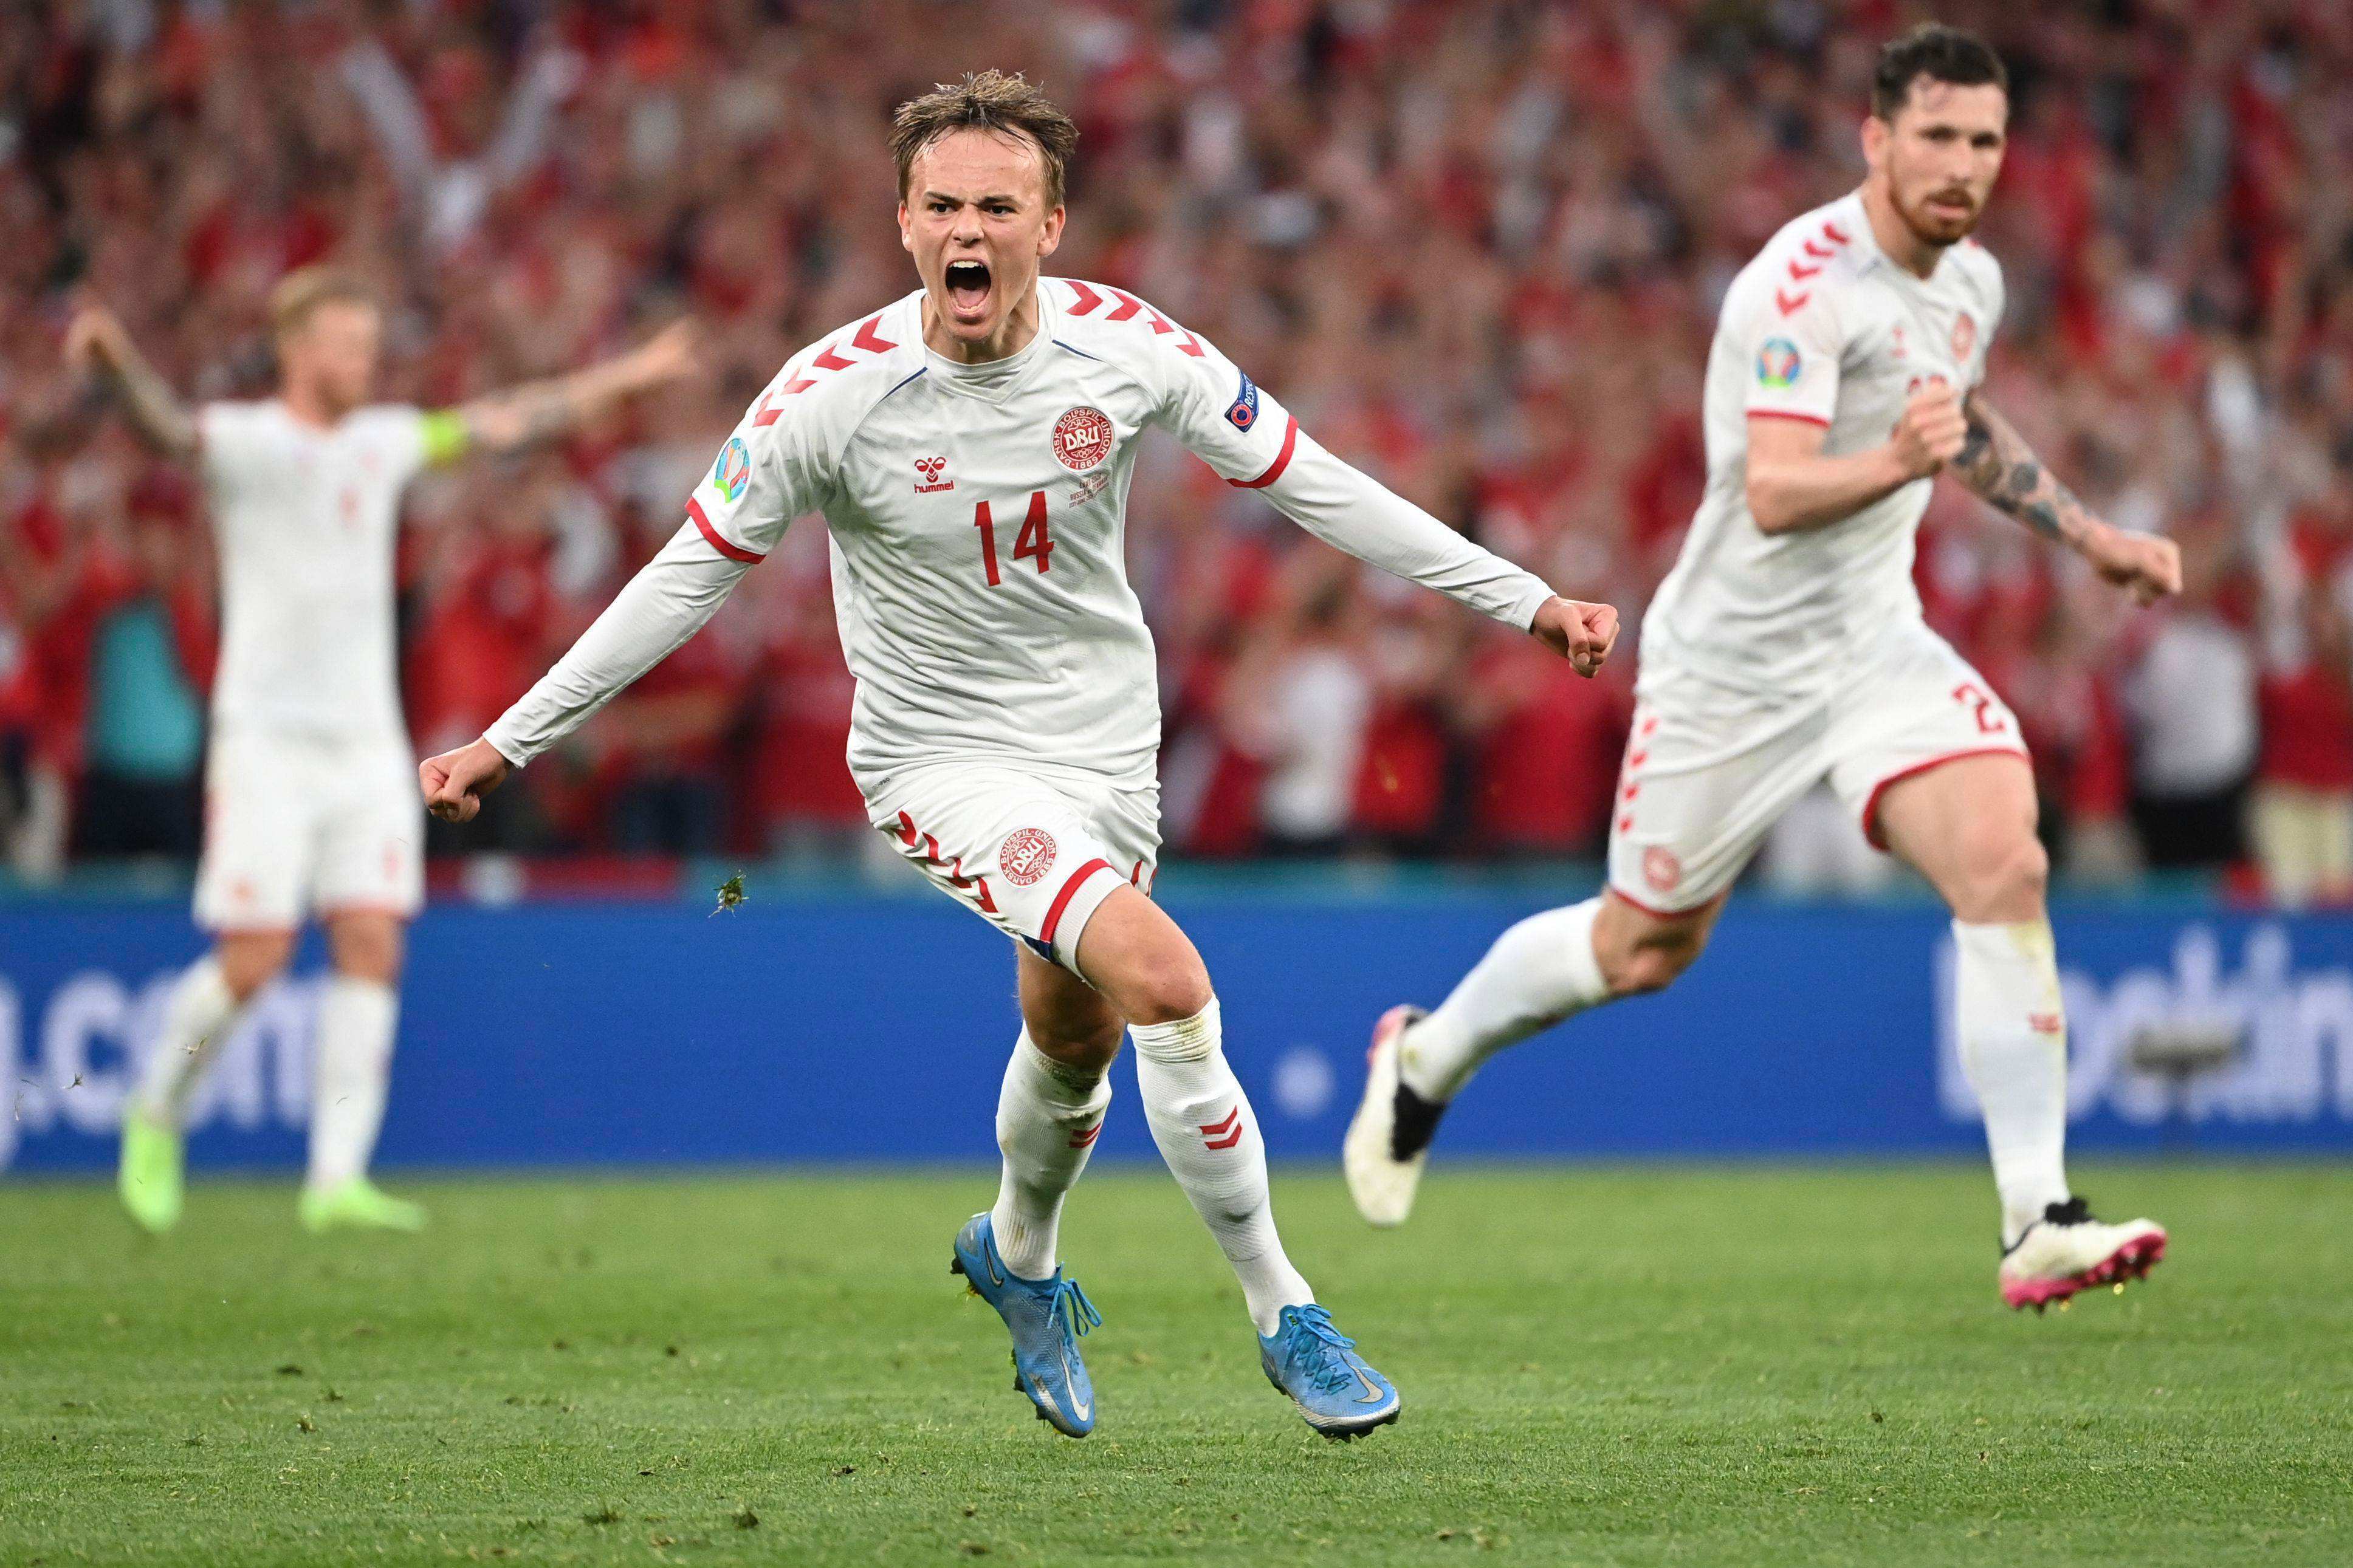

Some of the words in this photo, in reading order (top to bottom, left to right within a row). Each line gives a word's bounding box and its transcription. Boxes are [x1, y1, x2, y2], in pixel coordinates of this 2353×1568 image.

[1054, 431, 1071, 466] DANSK
[1099, 421, 1111, 455] UNION
[1063, 425, 1101, 451] DBU
[1075, 456, 1099, 469] 1889
[914, 480, 954, 493] hummel
[974, 490, 1055, 587] 14
[1010, 838, 1045, 875] DBU
